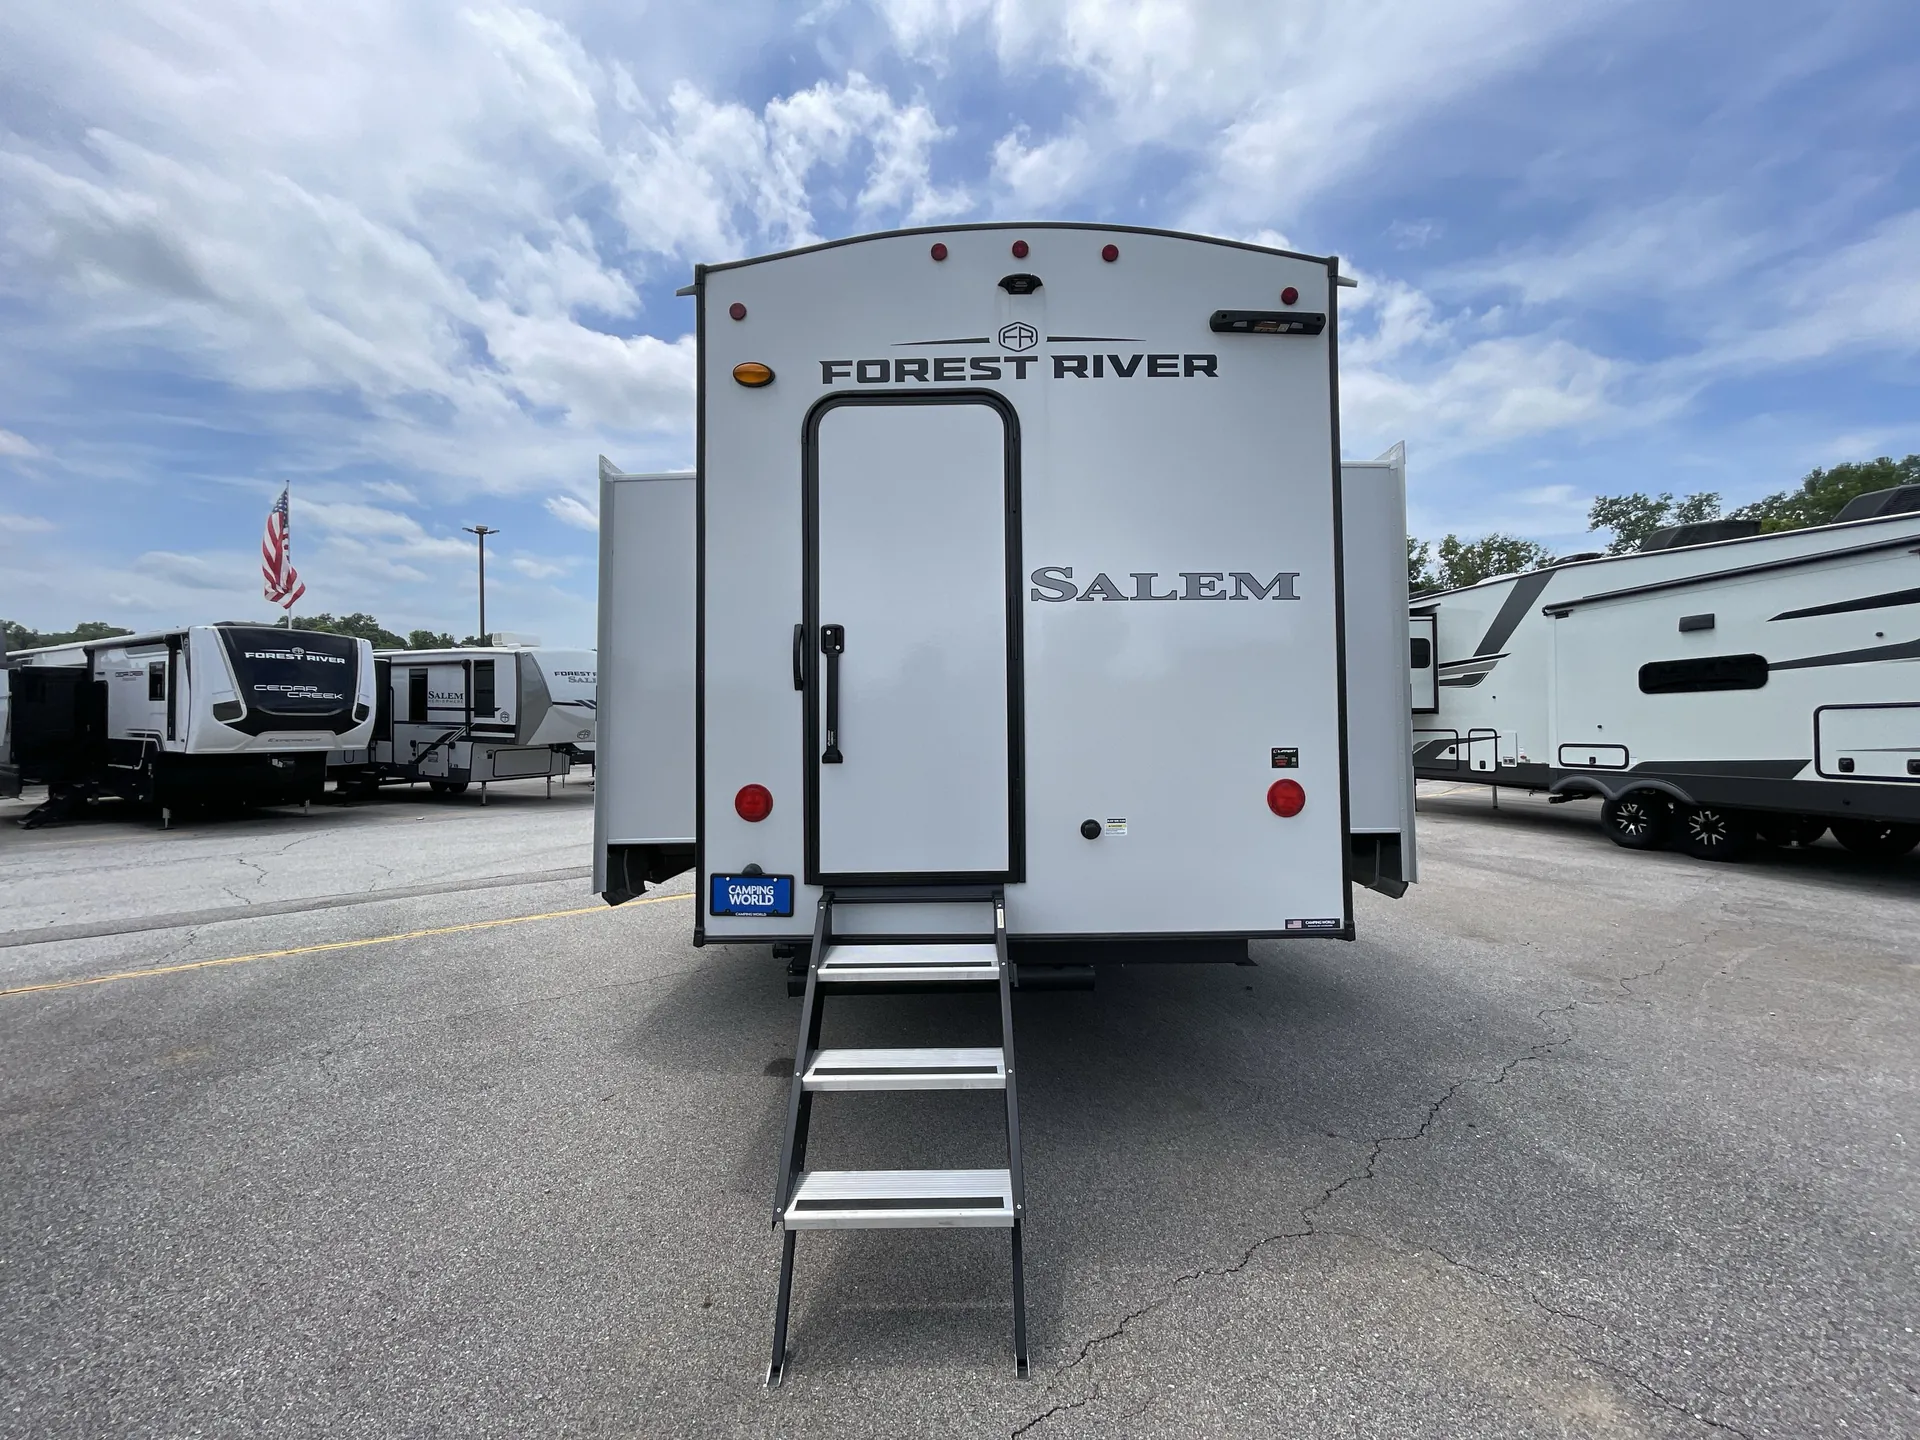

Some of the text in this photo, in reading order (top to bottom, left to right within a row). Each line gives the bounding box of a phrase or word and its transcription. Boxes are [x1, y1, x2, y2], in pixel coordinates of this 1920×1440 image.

[819, 353, 1220, 385] FOREST RIVER
[1030, 566, 1301, 602] SALEM
[244, 651, 346, 664] FOREST RIVER
[254, 684, 318, 692] CEDAR
[287, 691, 344, 700] CREEK
[428, 690, 464, 700] SALEM
[728, 885, 774, 895] CAMPING
[728, 894, 775, 906] WORLD
